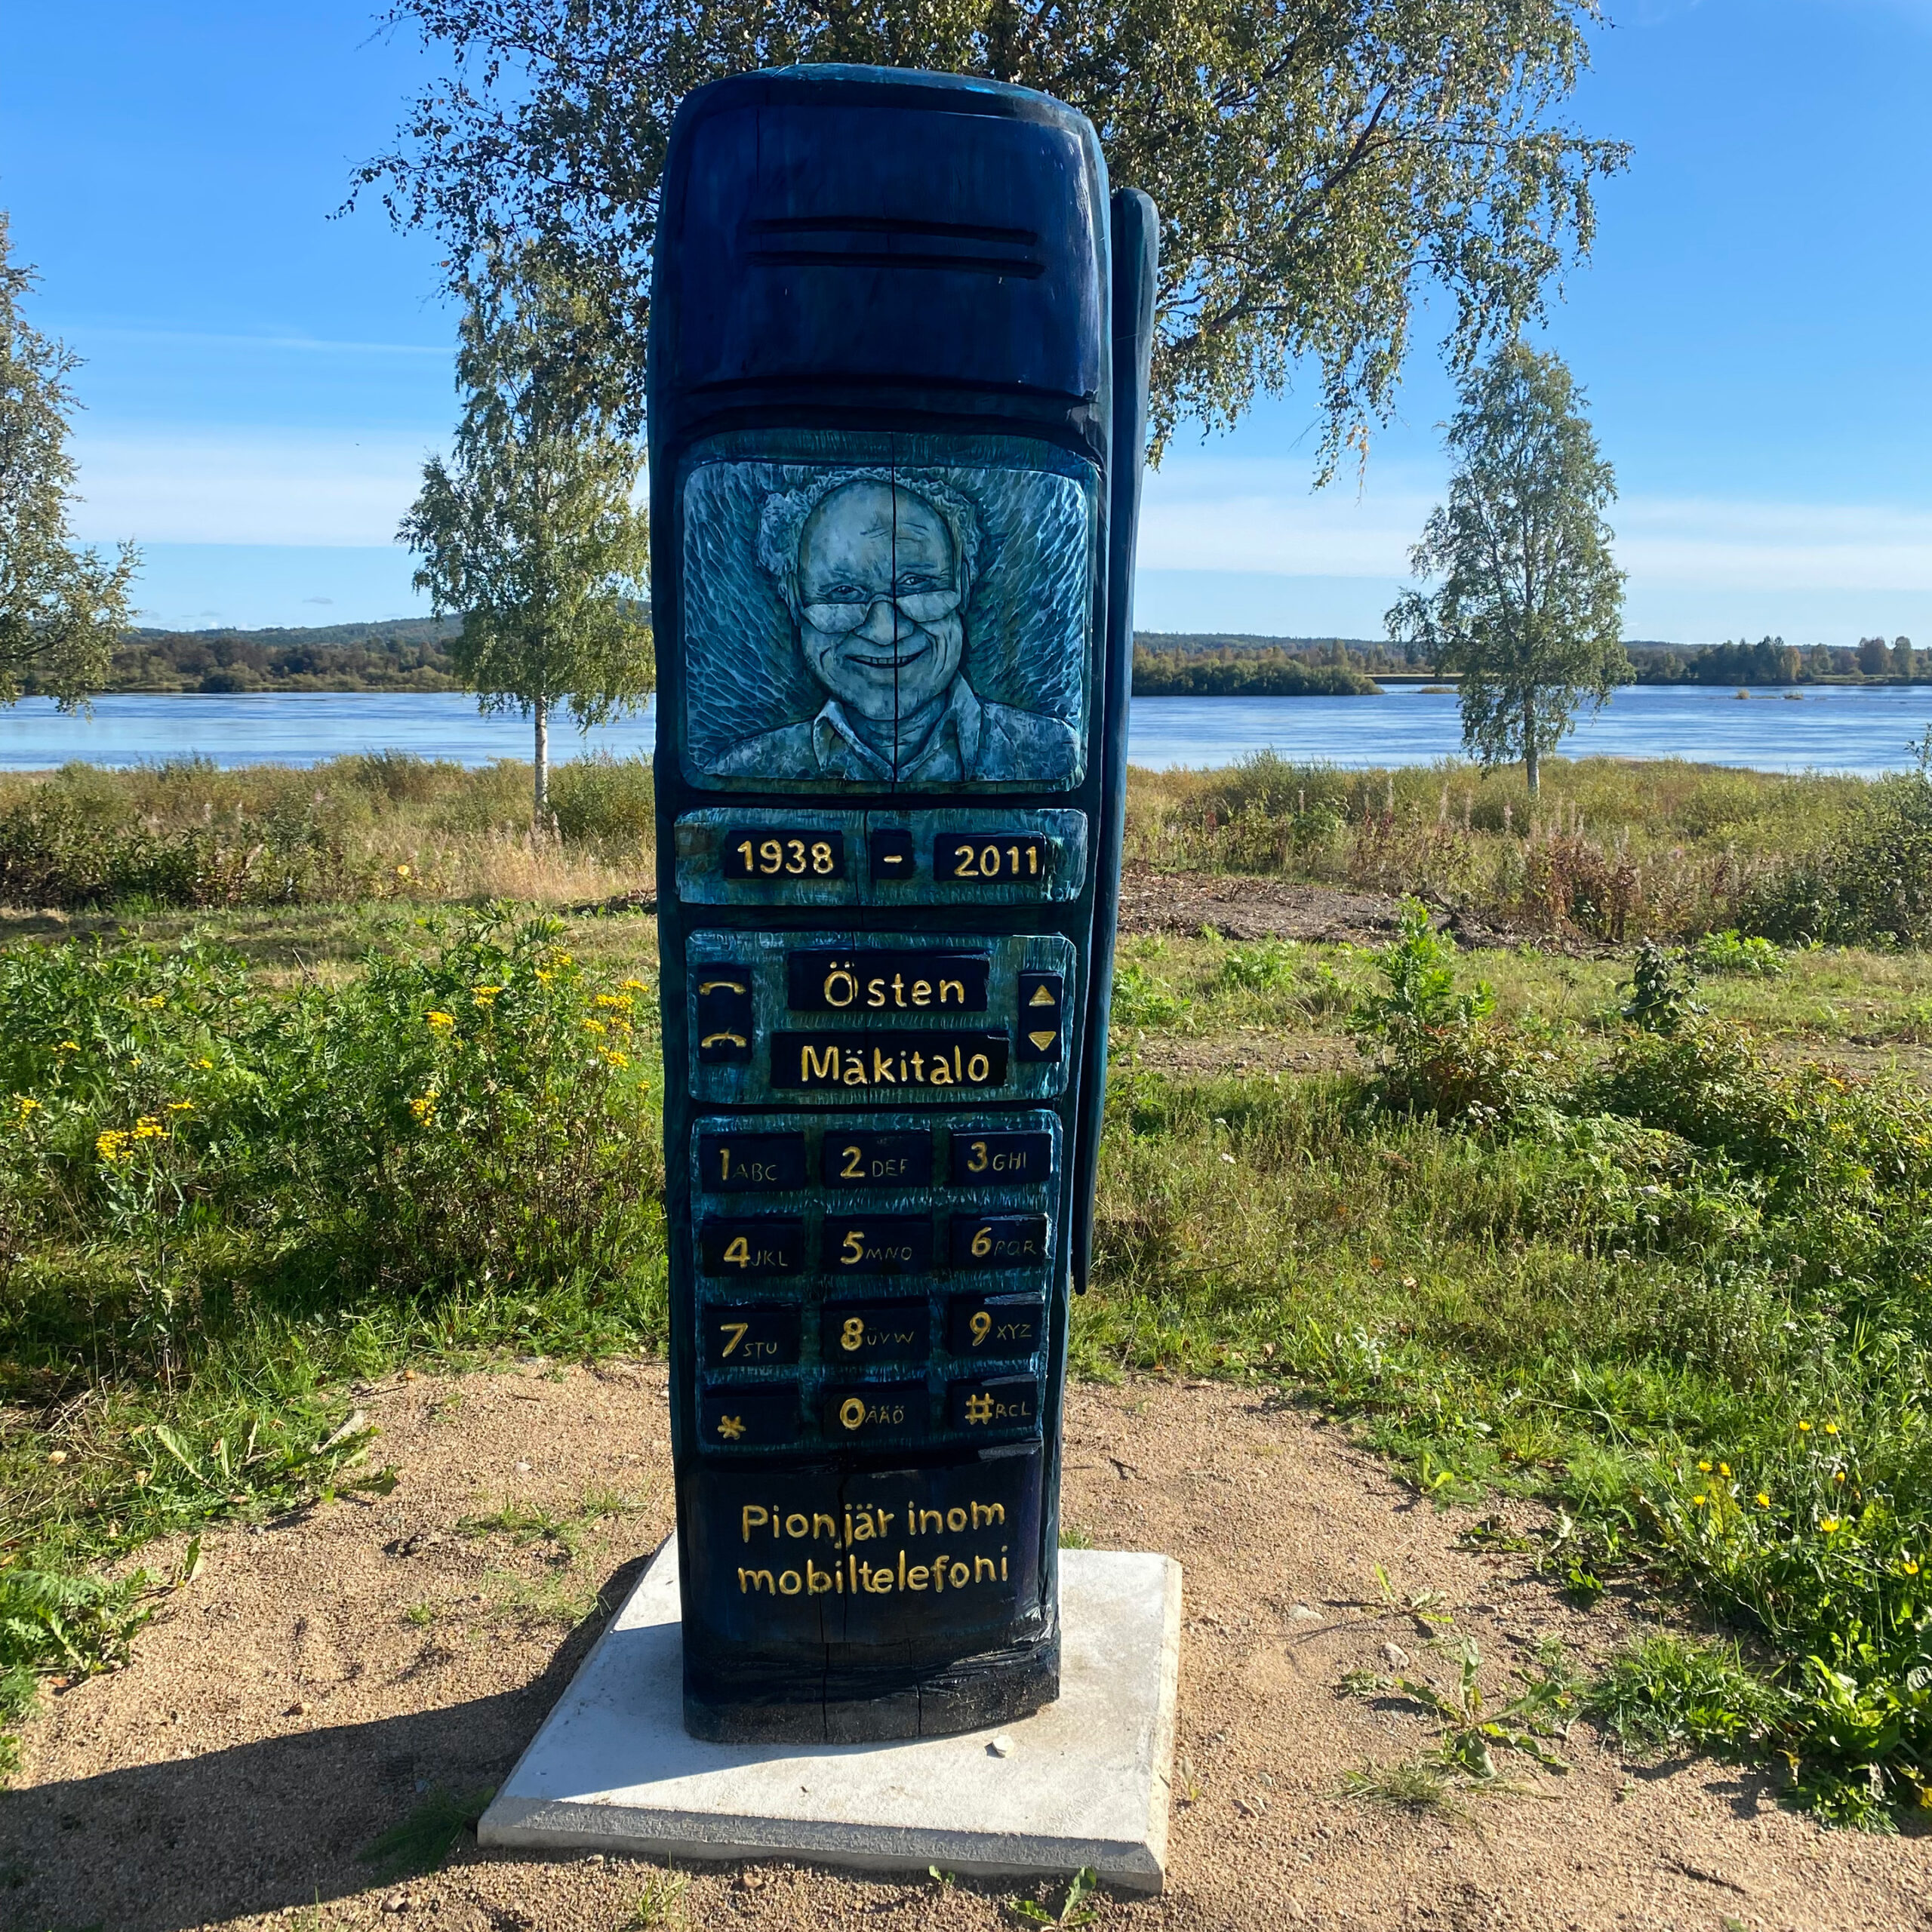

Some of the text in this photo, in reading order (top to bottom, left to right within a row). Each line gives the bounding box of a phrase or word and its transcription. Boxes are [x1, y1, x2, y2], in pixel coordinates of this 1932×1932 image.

[737, 838, 835, 875] 1938
[953, 844, 1038, 878] 2011
[823, 960, 965, 1008] Östen
[800, 1044, 990, 1085] Mäkitalo
[742, 1500, 1006, 1550] Pionjär inom
[737, 1544, 1008, 1596] mobiltelefoni
